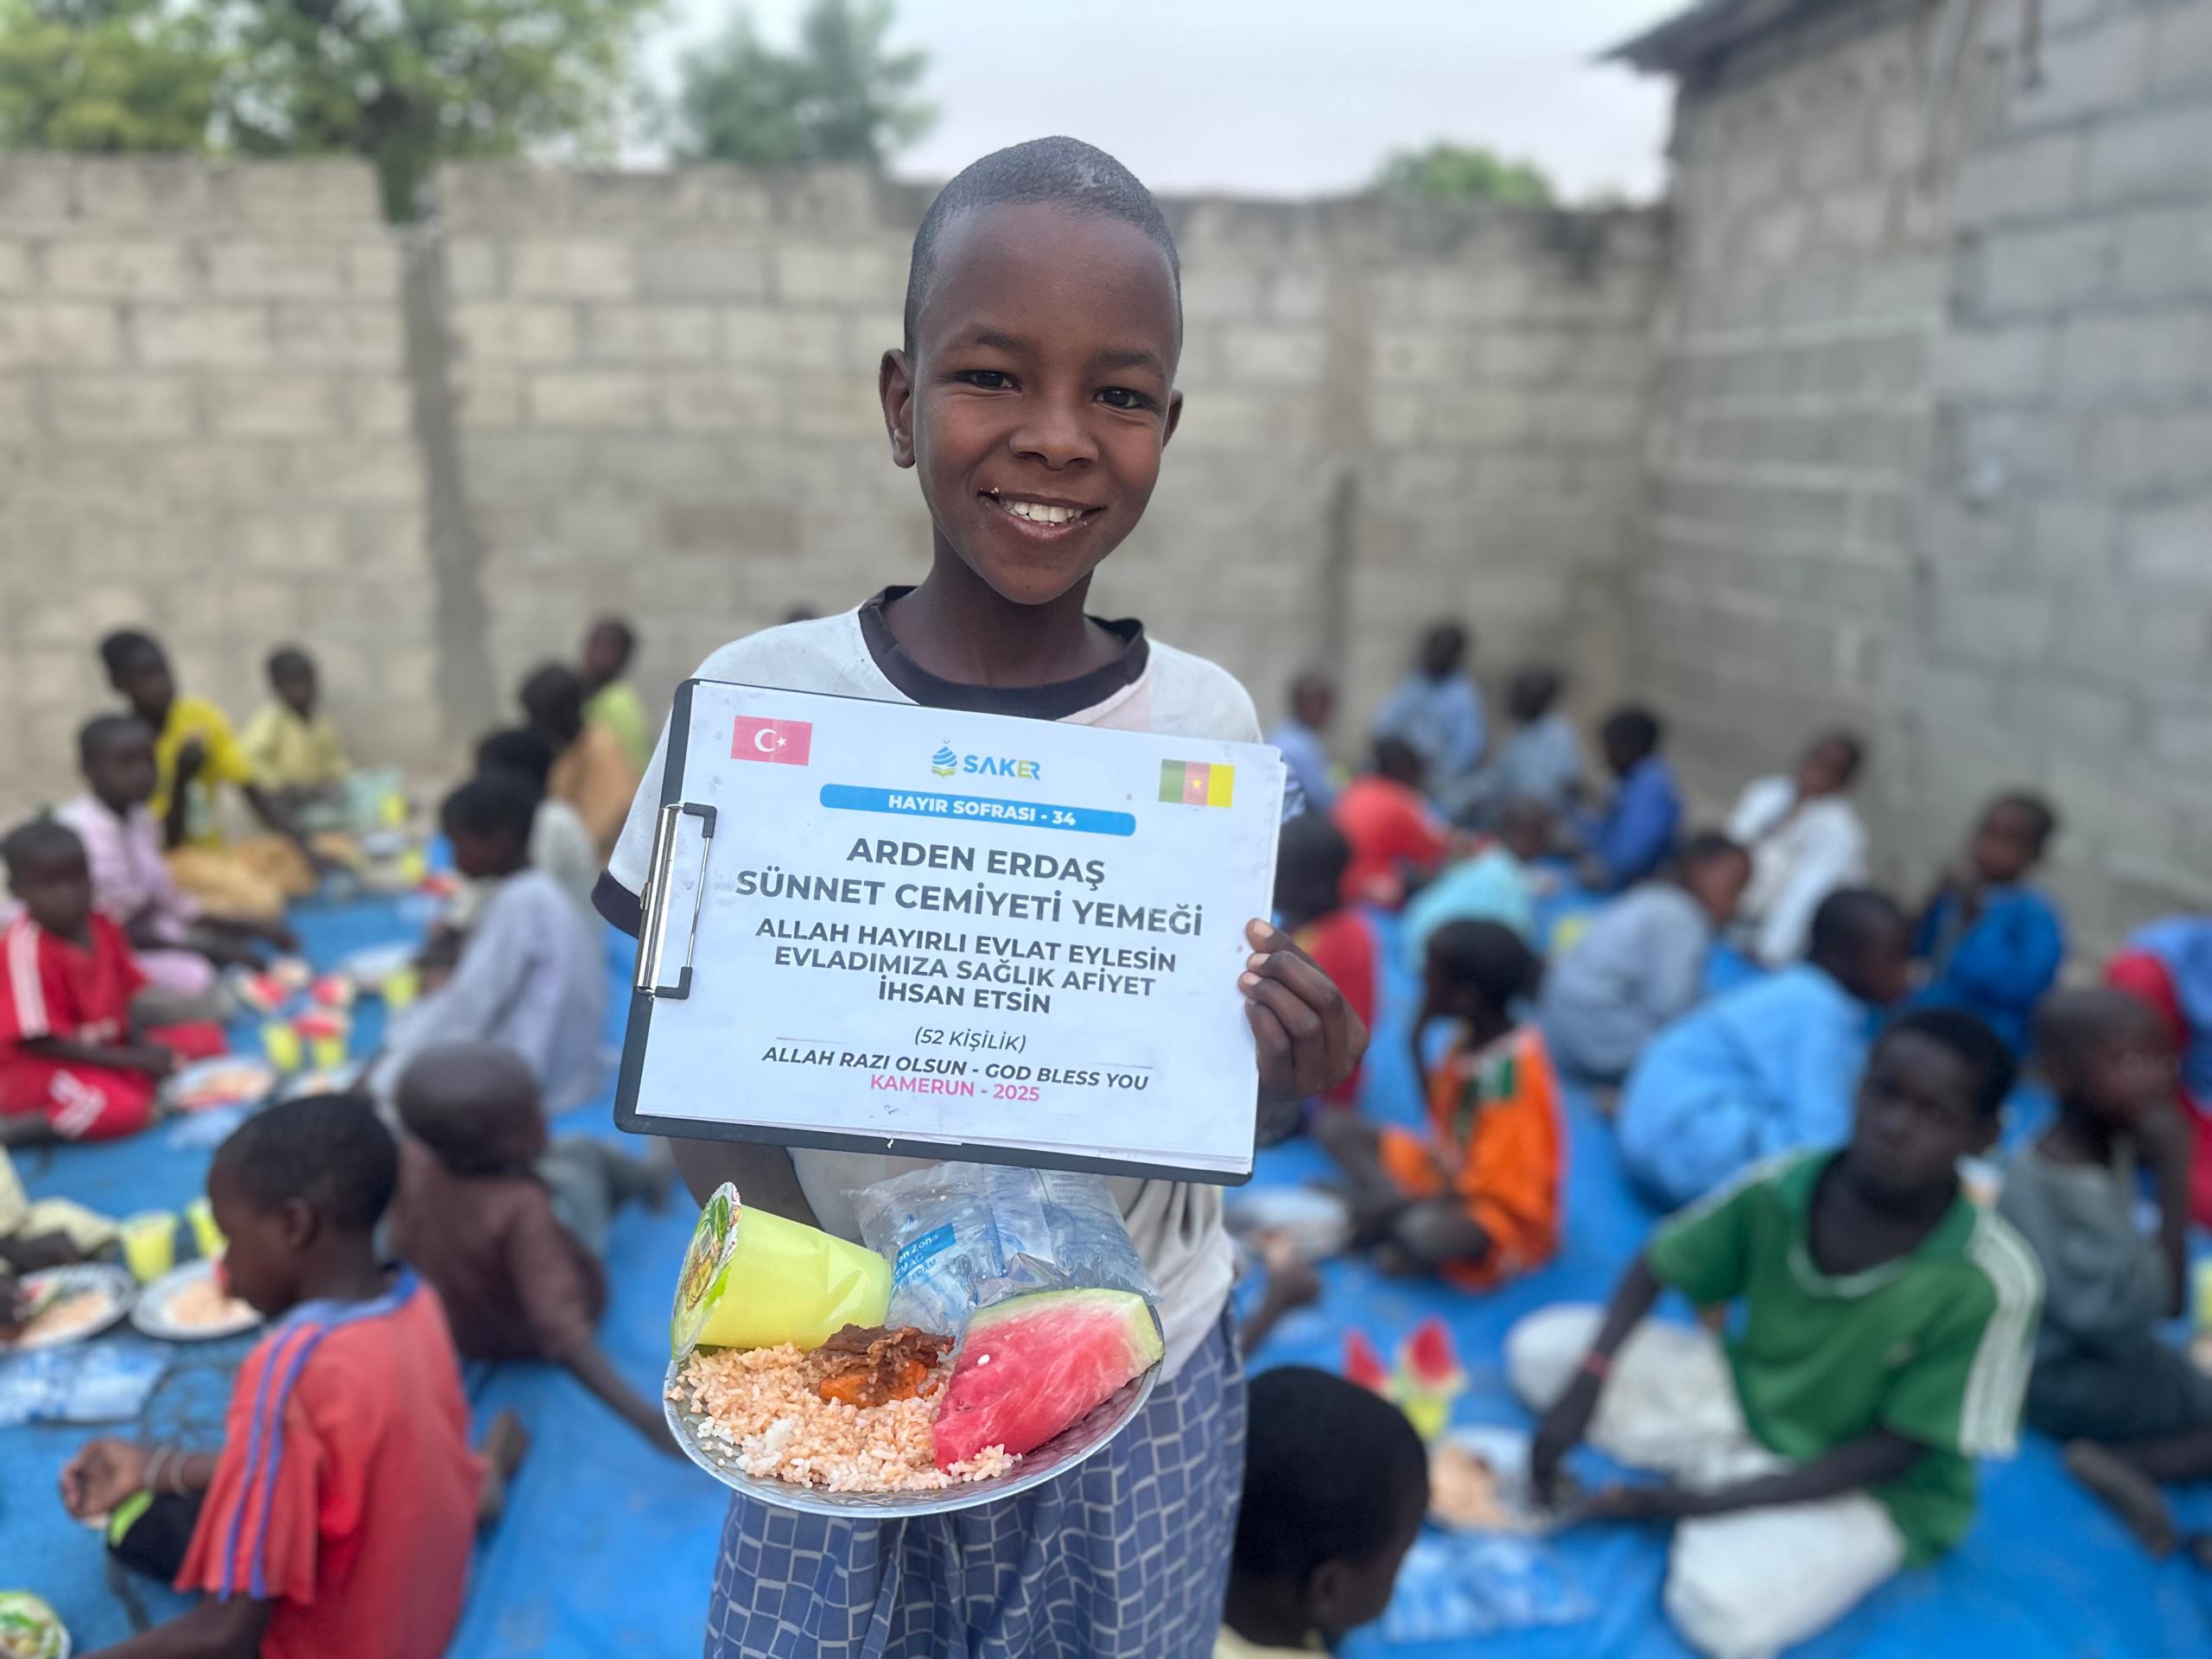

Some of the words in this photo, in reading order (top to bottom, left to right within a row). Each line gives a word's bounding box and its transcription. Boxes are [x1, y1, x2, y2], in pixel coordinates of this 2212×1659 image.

[962, 754, 1041, 781] SAKER
[887, 794, 949, 814] HAYIR
[952, 800, 1036, 822] SOFRASI
[1051, 810, 1077, 826] 34
[846, 837, 976, 872] ARDEN
[987, 849, 1105, 892] ERDAŞ
[735, 865, 886, 906] SÜNNET
[894, 881, 1062, 923] CEMİYETİ
[1071, 899, 1203, 937] YEMEĞİ
[754, 918, 849, 944] ALLAH
[857, 925, 967, 953] HAYIRLI
[975, 935, 1062, 962] EVLAT
[1068, 944, 1176, 973] EYLESİN
[774, 945, 949, 978] EVLADIMIZA
[956, 958, 1056, 988] SAĞLIK
[1060, 969, 1156, 996] AFİYET
[878, 974, 965, 1007] İHSAN
[973, 987, 1051, 1014] ETSİN
[914, 1026, 944, 1046] (52
[948, 1028, 1027, 1054] KİŞİLİK)
[760, 1046, 836, 1066] ALLAH
[838, 1052, 891, 1071] RAZI
[895, 1056, 968, 1076] OLSUN
[984, 1063, 1032, 1081] GOD
[1036, 1067, 1101, 1086] BLESS
[1106, 1072, 1149, 1091] YOU
[870, 1074, 975, 1097] KAMERUN
[993, 1084, 1040, 1102] 2025
